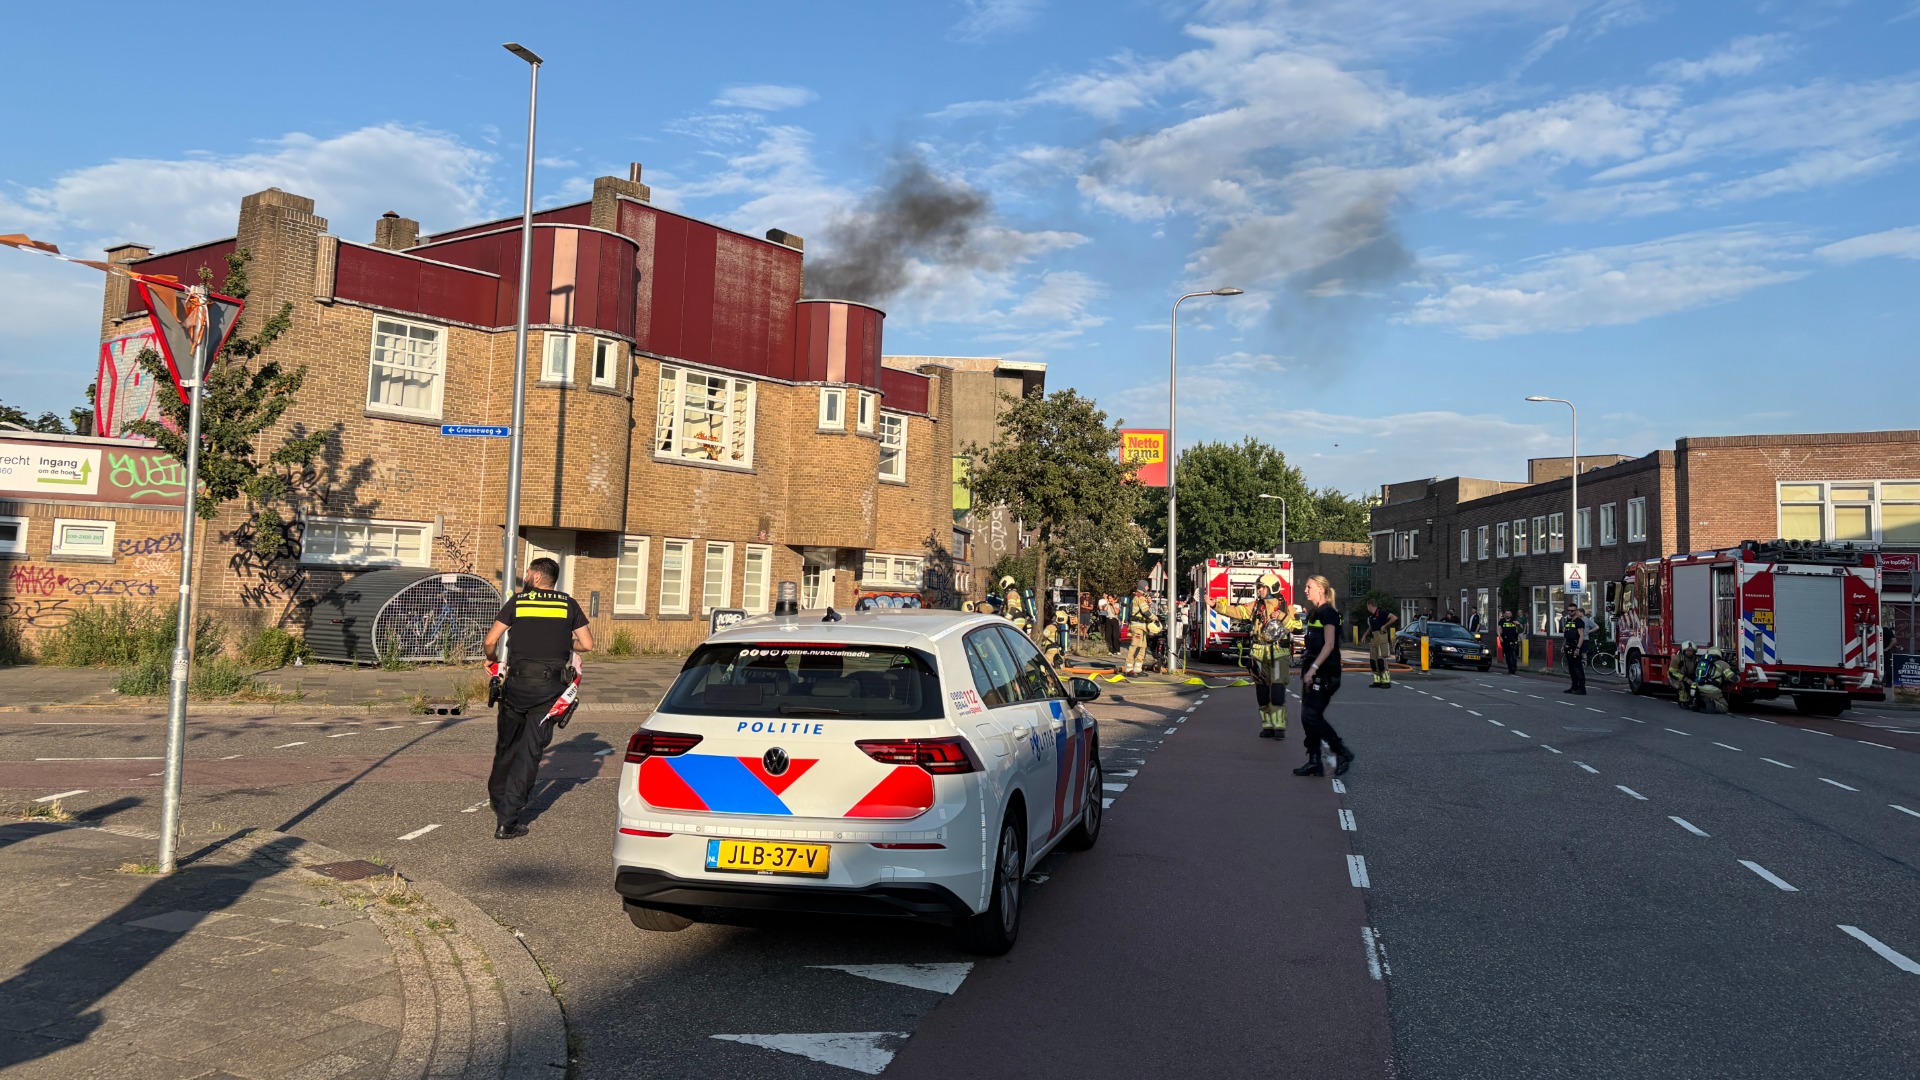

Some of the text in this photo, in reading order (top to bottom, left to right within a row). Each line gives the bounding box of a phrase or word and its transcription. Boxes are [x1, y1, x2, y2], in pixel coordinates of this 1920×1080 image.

[456, 426, 494, 434] Groeneweg
[1128, 437, 1160, 449] Netto
[1128, 449, 1159, 458] rama
[40, 456, 78, 469] Ingang
[258, 568, 278, 583] NO
[963, 689, 978, 704] 112
[737, 721, 824, 735] POLITIE
[708, 855, 717, 863] NL
[727, 845, 818, 868] JLB-37-V
